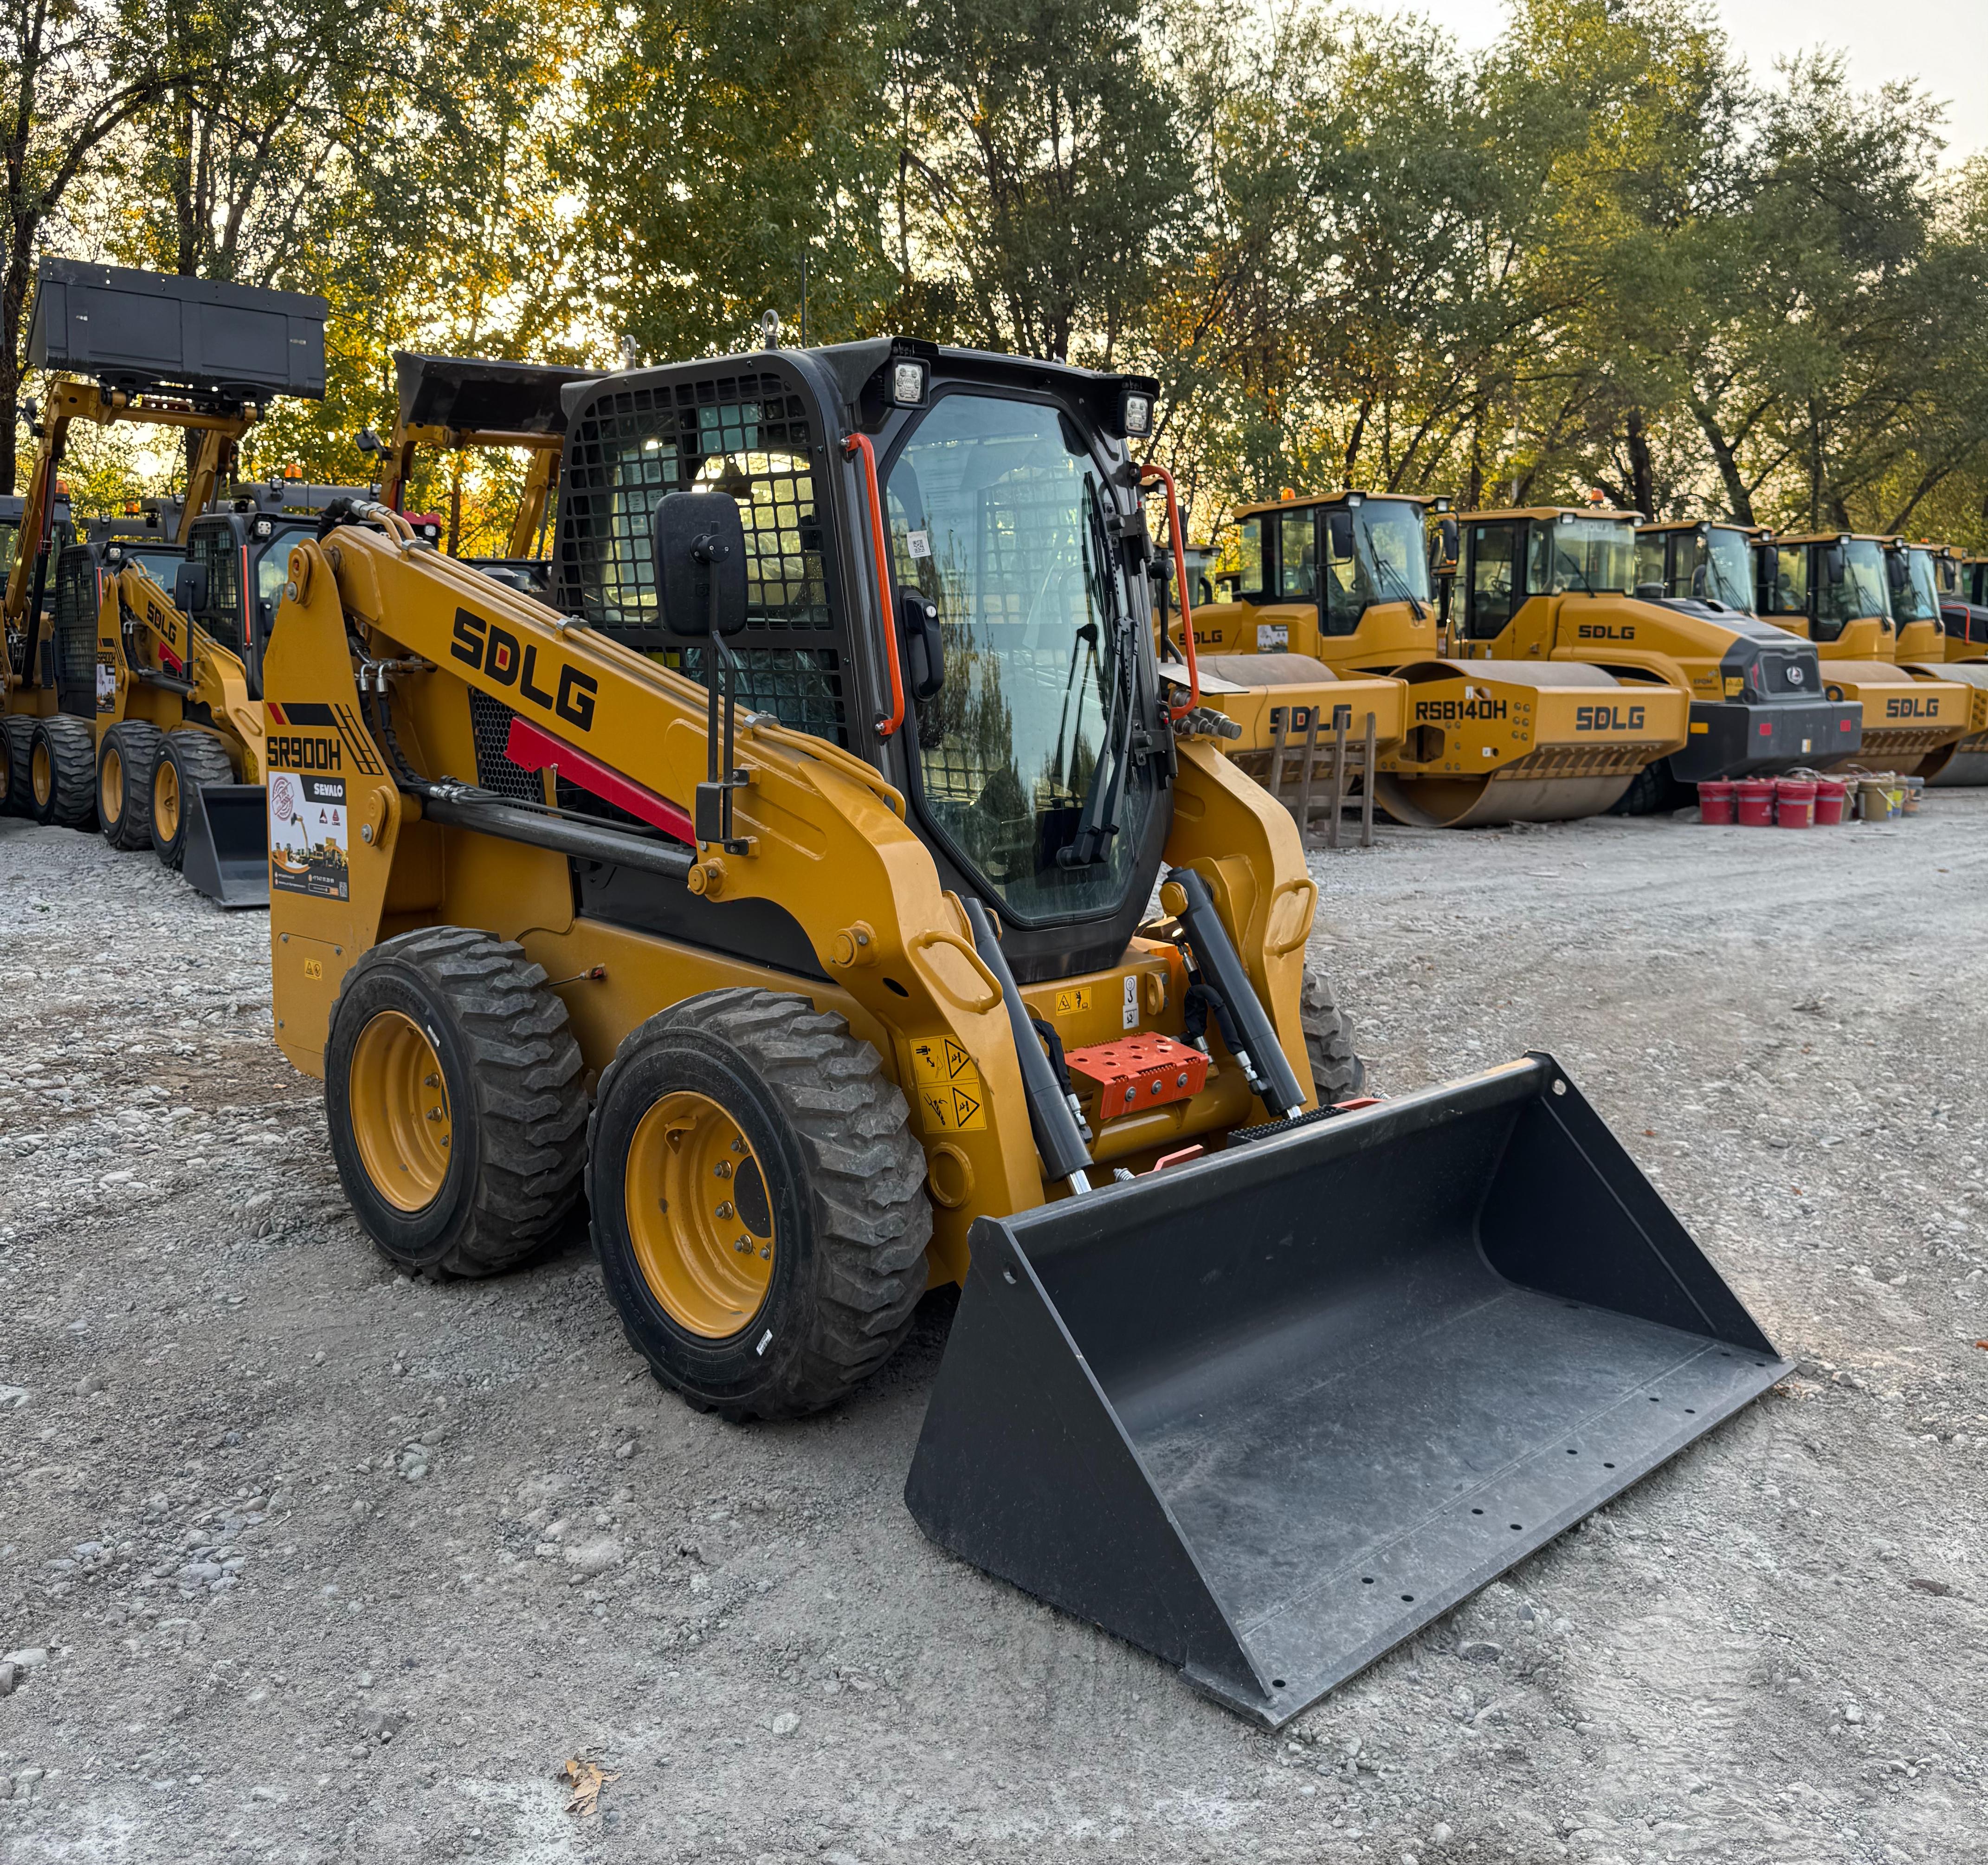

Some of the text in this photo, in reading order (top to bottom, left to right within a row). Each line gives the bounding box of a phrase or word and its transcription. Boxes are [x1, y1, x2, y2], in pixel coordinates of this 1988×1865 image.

[147, 600, 176, 646] SDLG
[1579, 625, 1635, 640] SDLG
[450, 607, 598, 732] SDLG
[1576, 706, 1645, 731] SDLG
[1886, 698, 1939, 718] SDLG
[267, 736, 341, 771] SR900H
[314, 783, 343, 797] SEVALO
